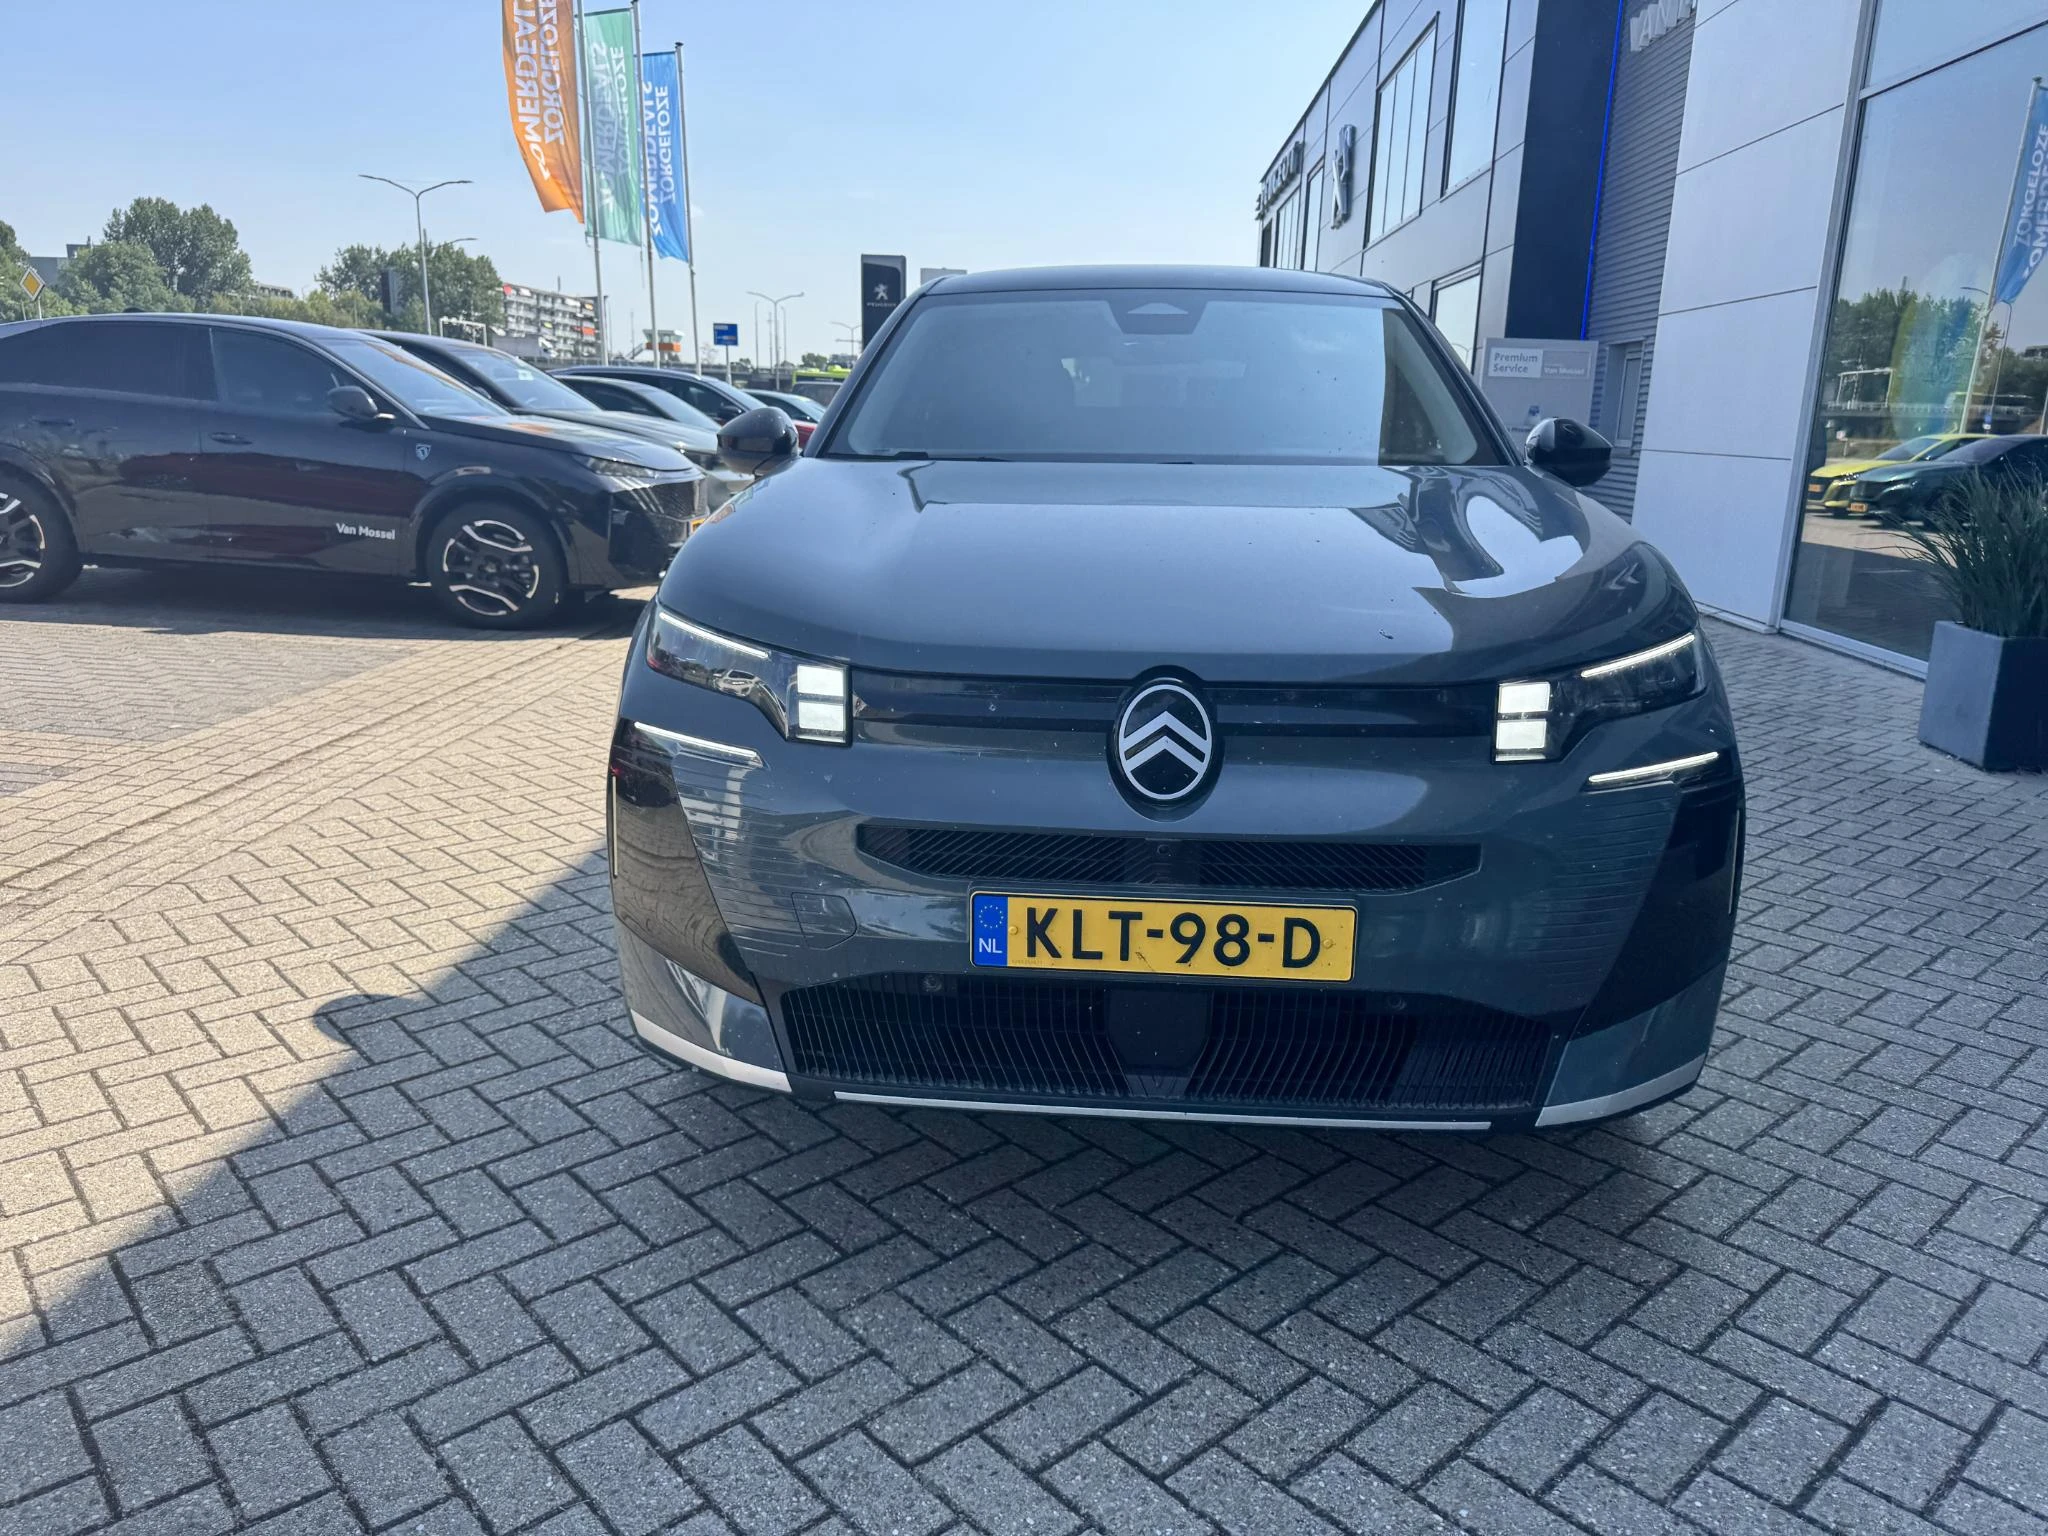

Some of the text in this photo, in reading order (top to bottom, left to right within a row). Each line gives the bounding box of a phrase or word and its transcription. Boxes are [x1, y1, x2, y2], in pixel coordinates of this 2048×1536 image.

[2014, 123, 2048, 248] ZORGELOZE
[1494, 352, 1537, 363] Premium
[1493, 363, 1528, 373] Service
[336, 523, 395, 539] Van Mossel
[978, 937, 1003, 954] NL
[1026, 907, 1321, 968] KLT-98-D
